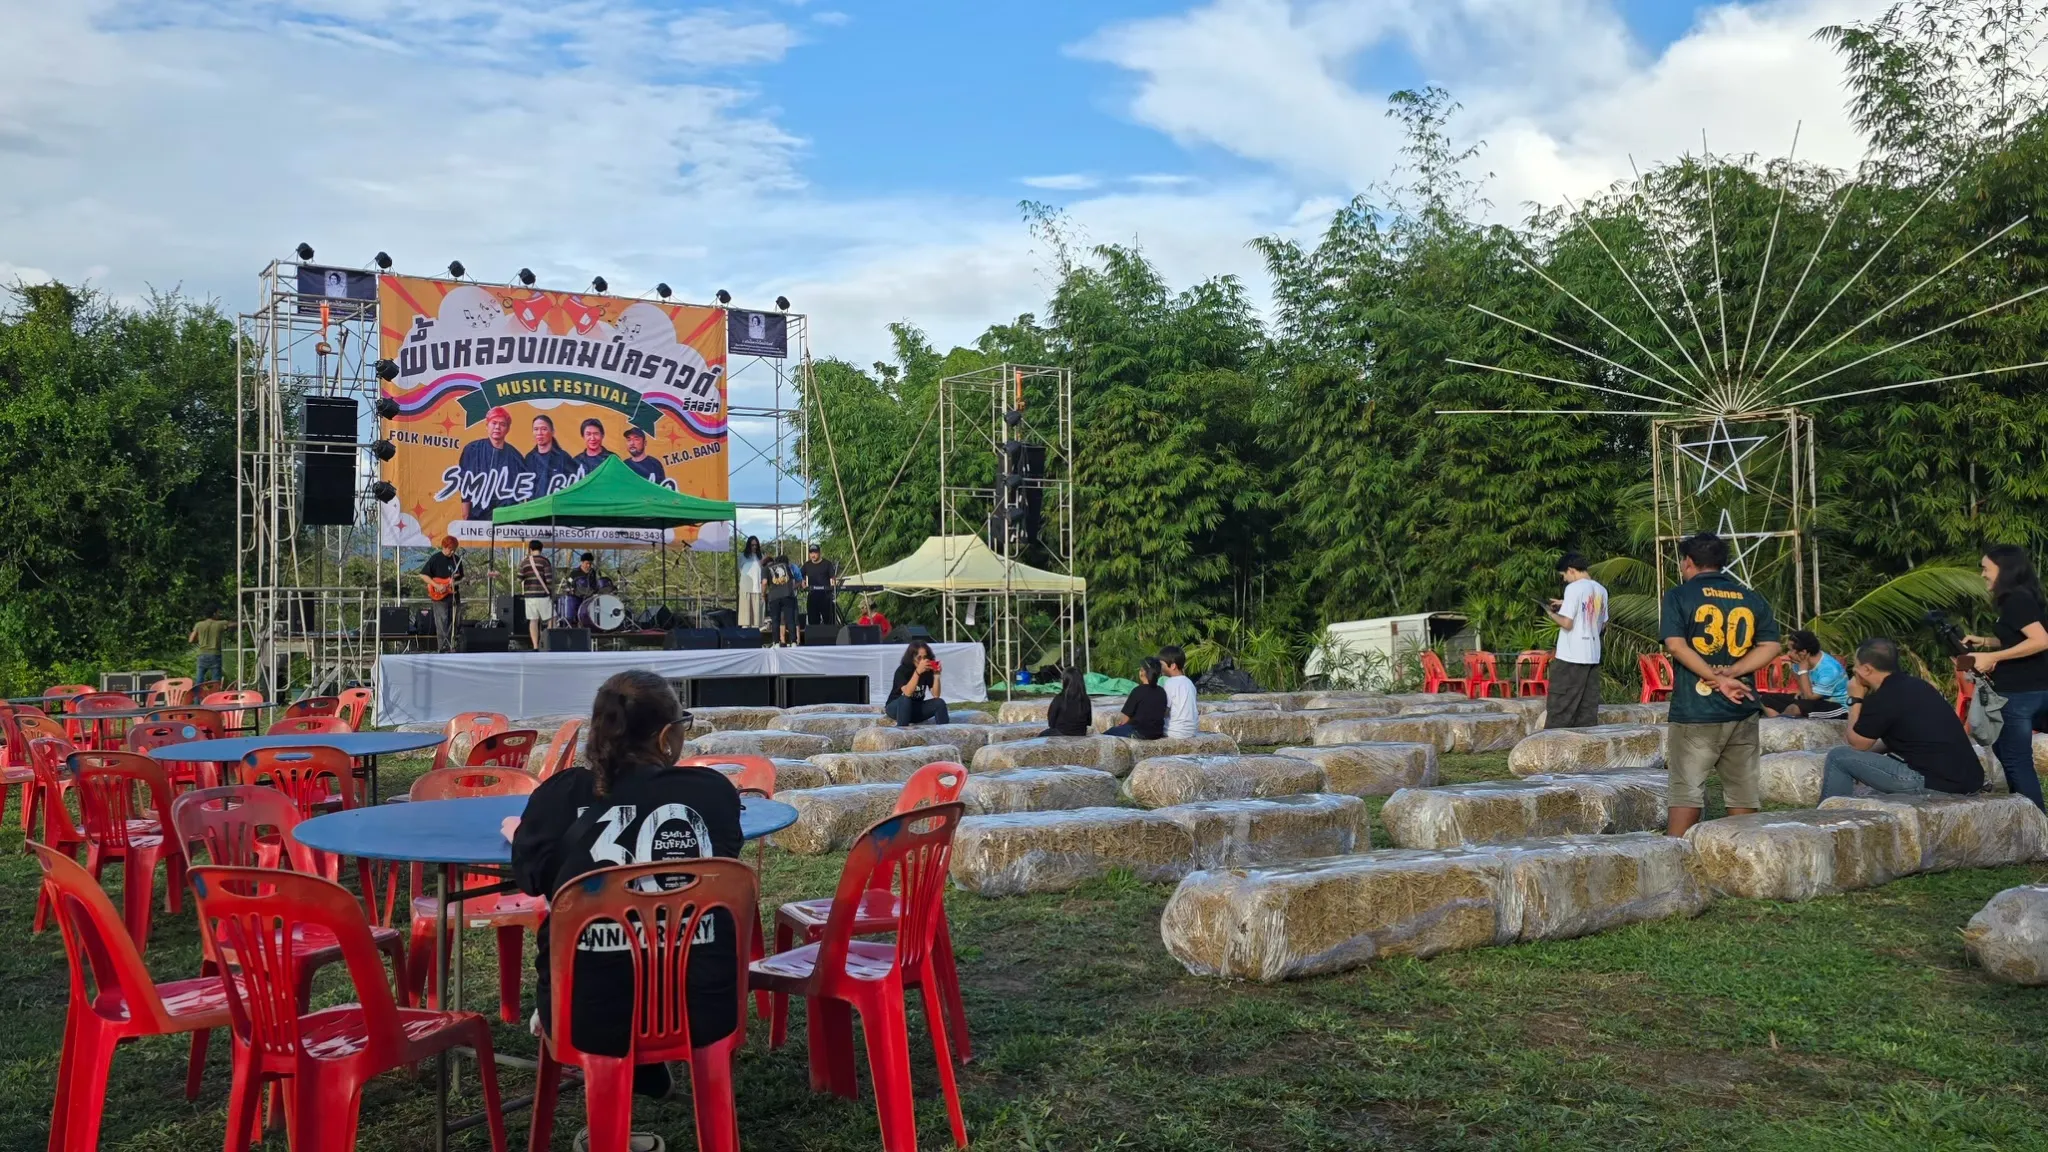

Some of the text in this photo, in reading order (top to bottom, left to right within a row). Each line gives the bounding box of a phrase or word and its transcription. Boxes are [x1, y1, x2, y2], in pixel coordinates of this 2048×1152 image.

[496, 378, 629, 405] MUSIC FESTIVAL
[389, 430, 460, 449] FOLK MUSIC
[662, 441, 721, 466] T.K.O. BAND
[433, 464, 537, 510] SMILE
[460, 527, 484, 537] LINE
[1692, 603, 1755, 658] 30
[653, 837, 697, 850] BUFFALO
[660, 831, 691, 840] SMILE
